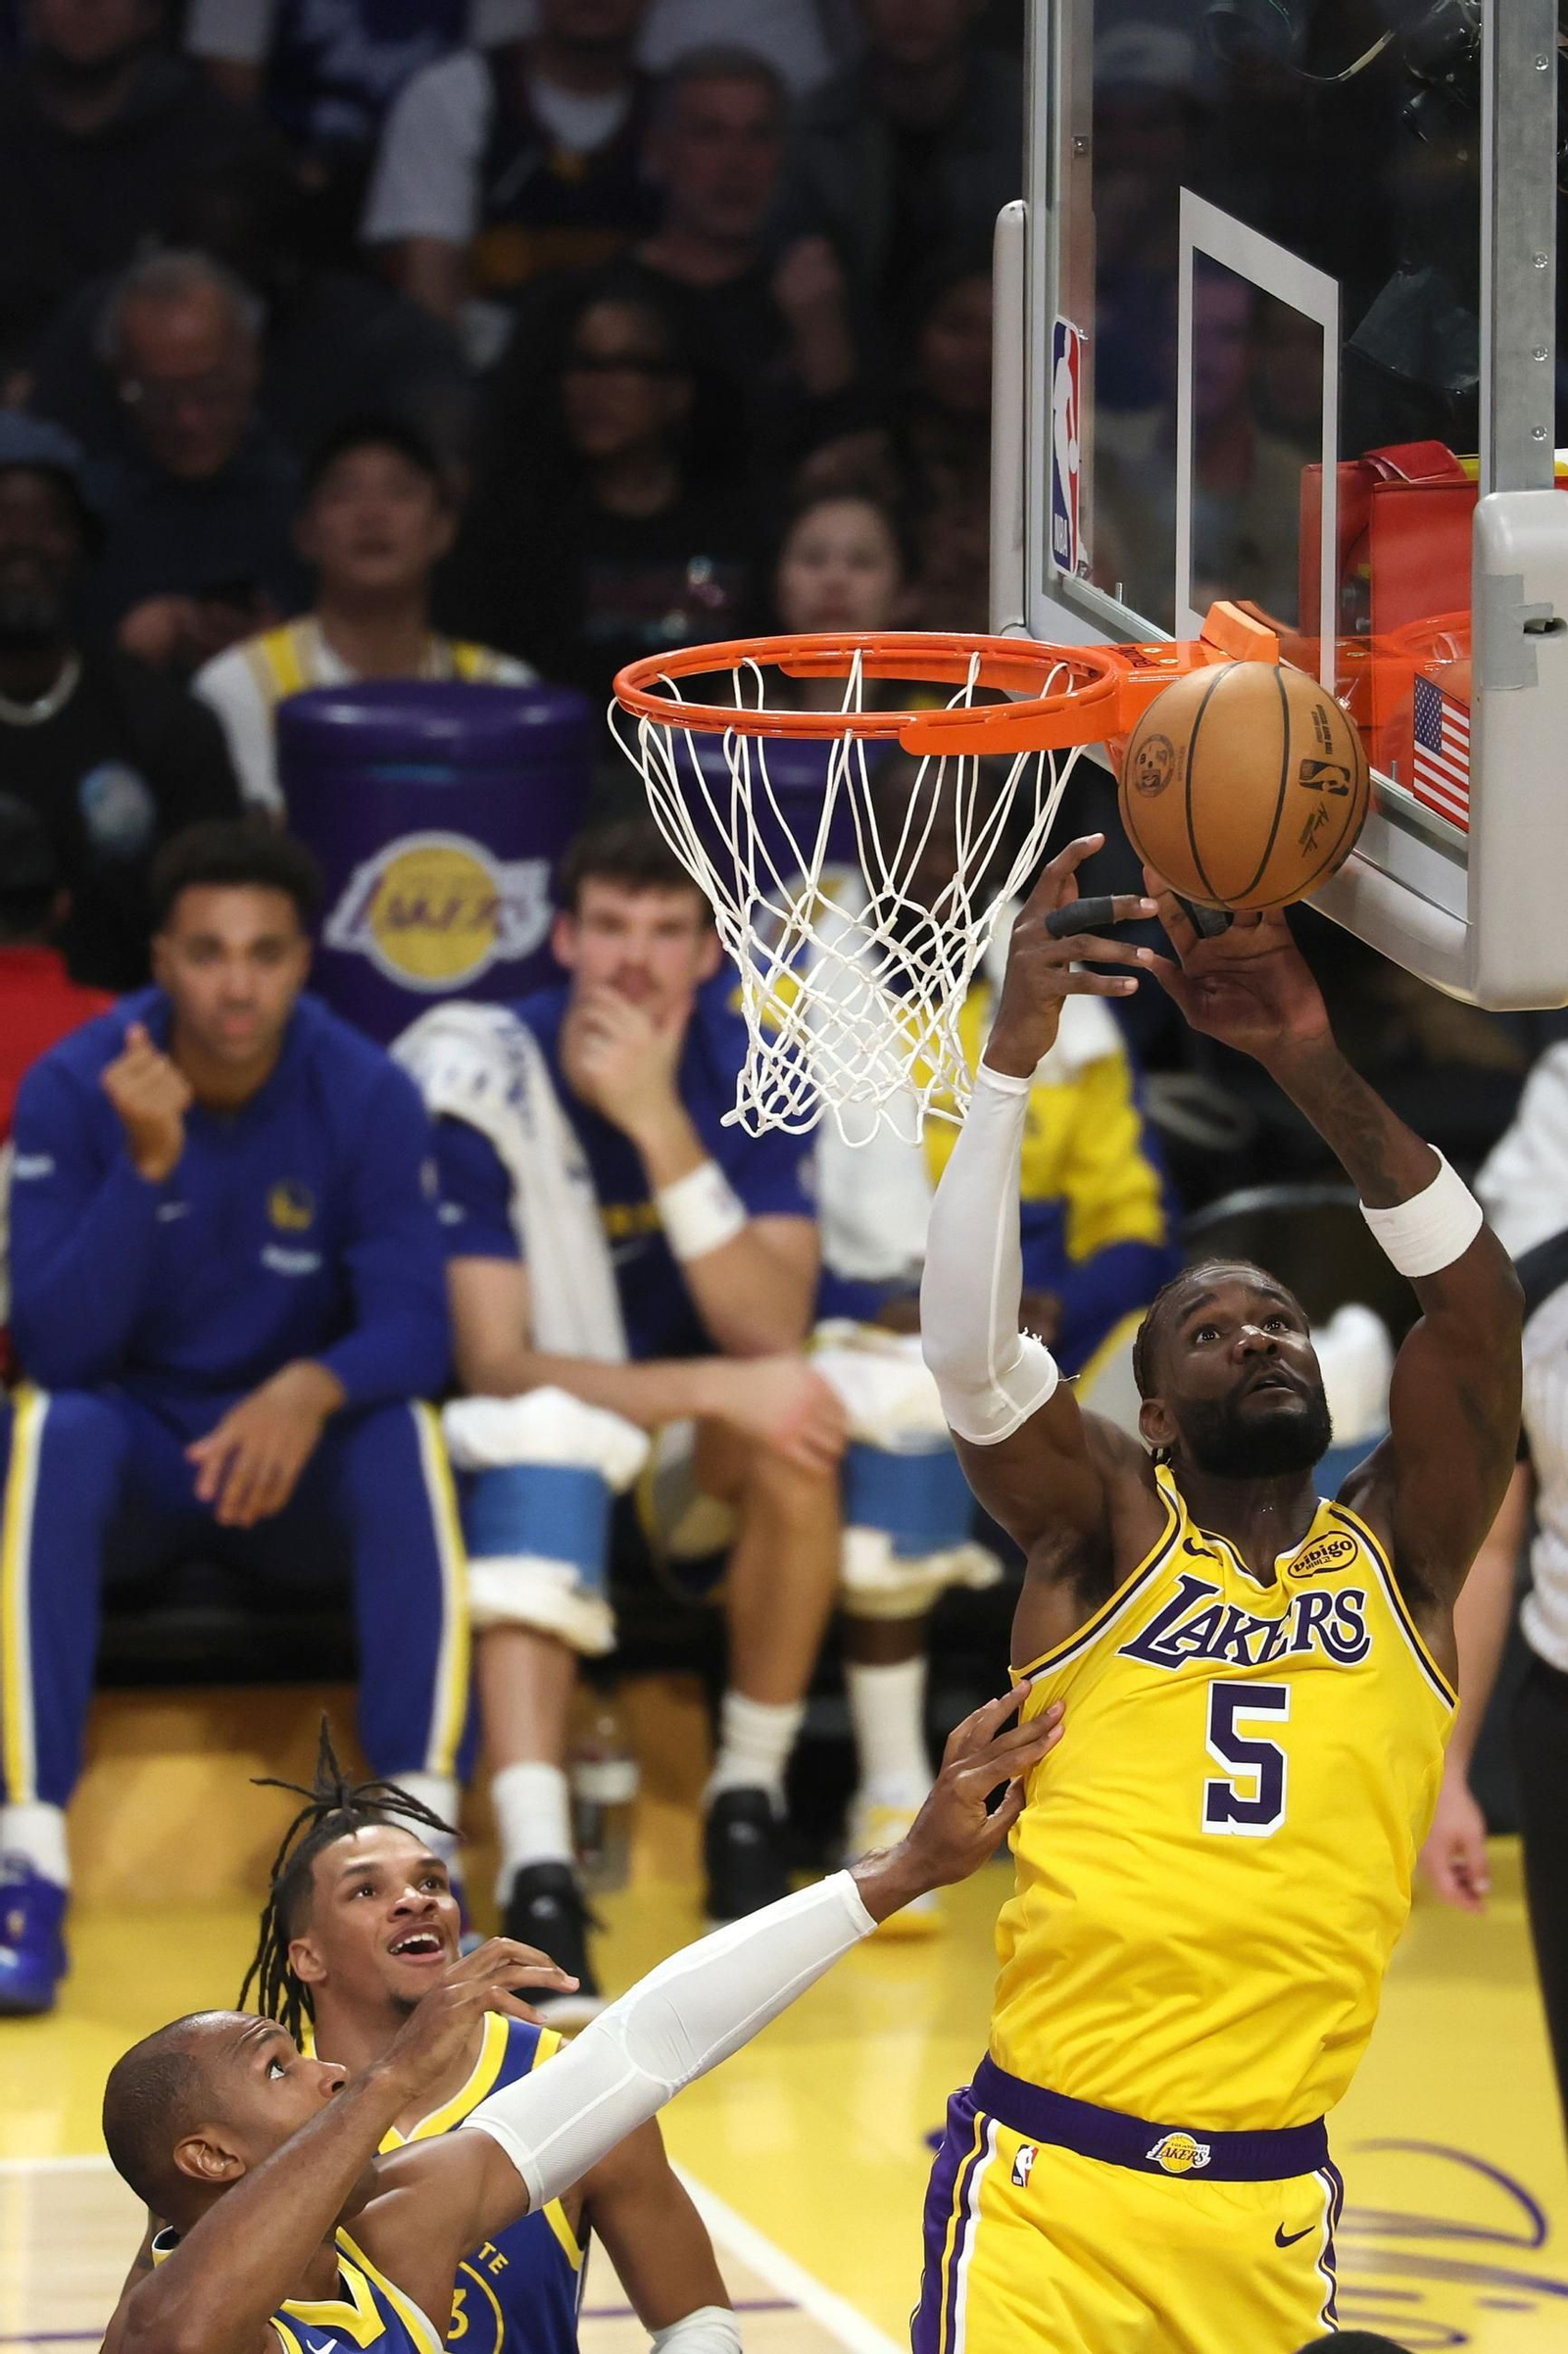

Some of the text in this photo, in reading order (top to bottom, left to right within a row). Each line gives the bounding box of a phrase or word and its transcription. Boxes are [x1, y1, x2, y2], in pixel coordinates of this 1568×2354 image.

[1054, 513, 1068, 558] NBA
[1294, 1540, 1353, 1573] bibigo
[1115, 1572, 1372, 1671] LAKERS
[1202, 1680, 1292, 1838] 5
[1149, 2140, 1209, 2166] LAKERS
